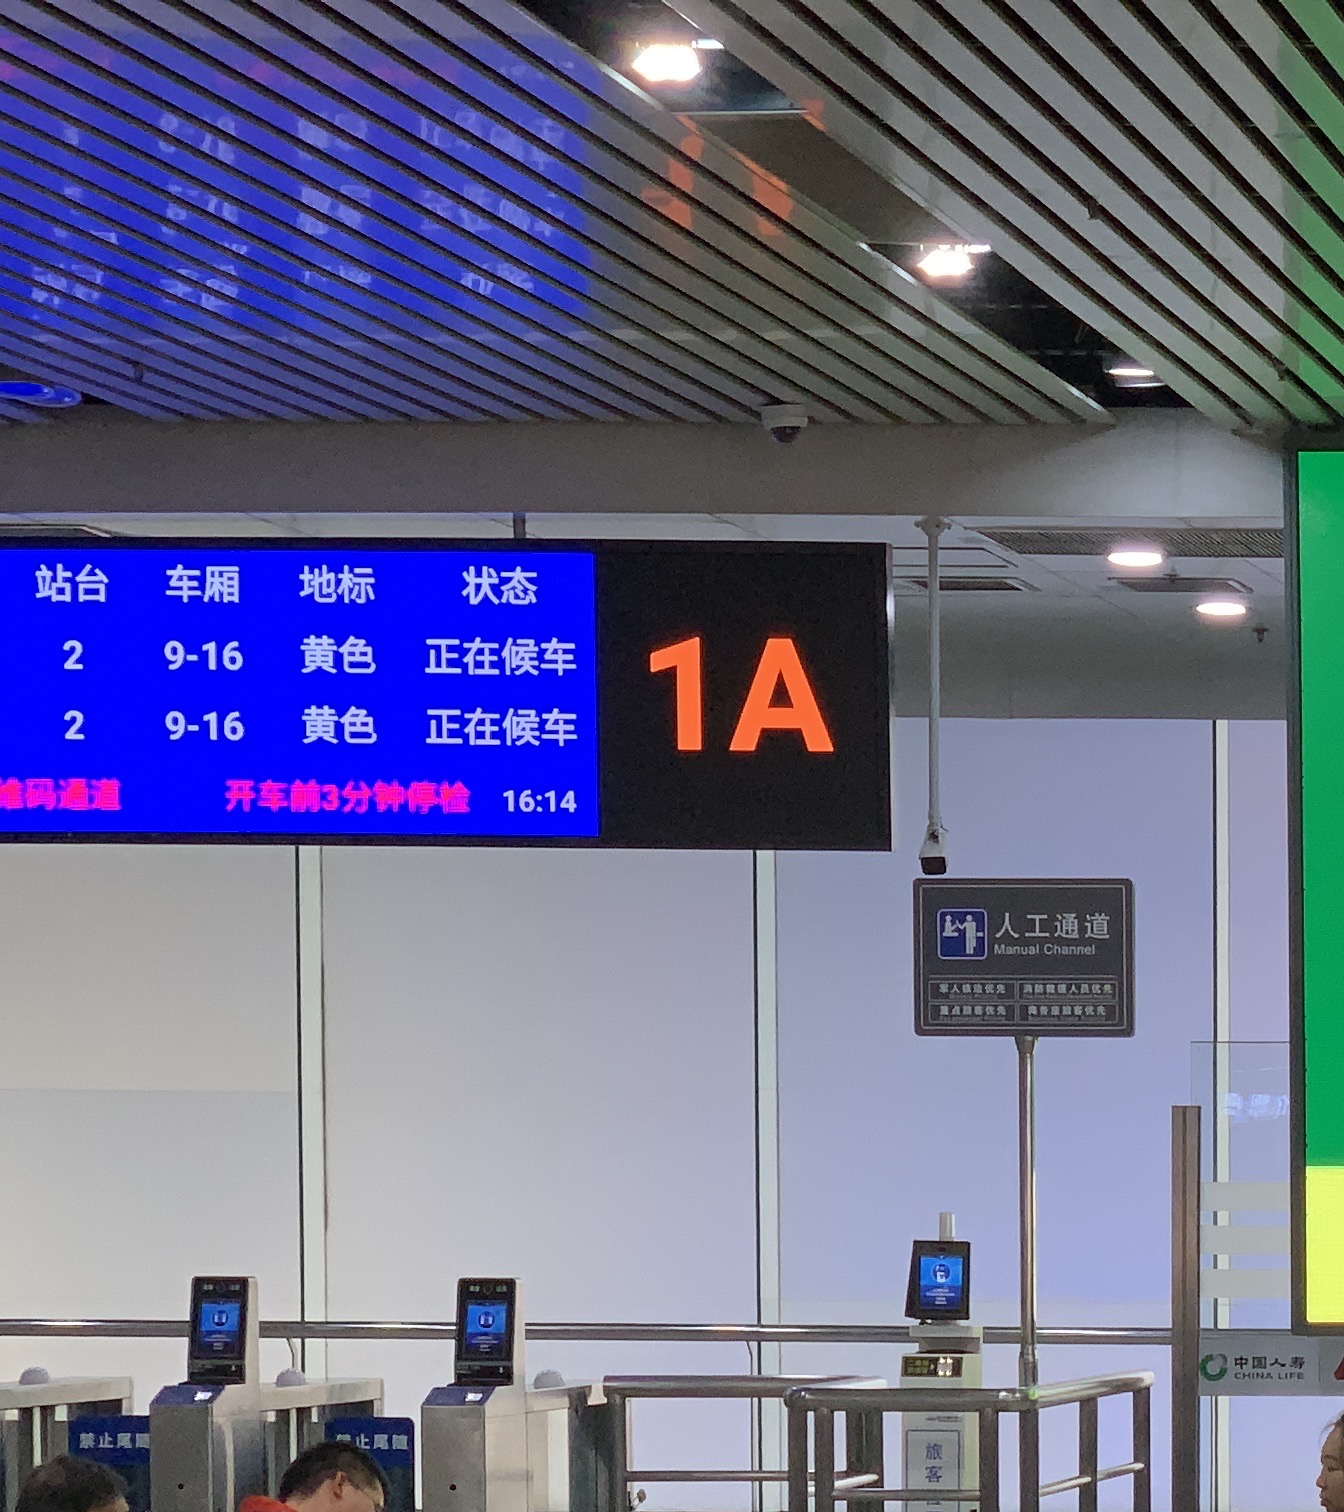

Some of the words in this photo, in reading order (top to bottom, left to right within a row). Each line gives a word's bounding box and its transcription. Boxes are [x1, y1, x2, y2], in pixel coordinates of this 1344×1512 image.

[35, 563, 109, 603] 站台
[165, 564, 241, 603] 车厢
[299, 564, 376, 604] 地标
[461, 565, 538, 605] 状态
[63, 639, 84, 670] 2
[163, 640, 244, 671] 9-16
[300, 634, 376, 674] 黄色
[424, 637, 577, 676] 正在候车
[650, 637, 834, 753] 1A
[63, 710, 85, 740] 2
[164, 710, 245, 741] 9-16
[301, 705, 378, 744] 黄色
[425, 707, 578, 747] 正在候车
[225, 780, 471, 815] 开车前3分钟停检
[503, 789, 577, 813] 16:14
[994, 911, 1111, 940] 人工通道
[994, 943, 1040, 955] Manual
[1044, 943, 1096, 955] Channel
[1234, 1356, 1306, 1370] 中国人寿
[1234, 1372, 1274, 1380] CHINA
[1278, 1372, 1305, 1380] LIFE
